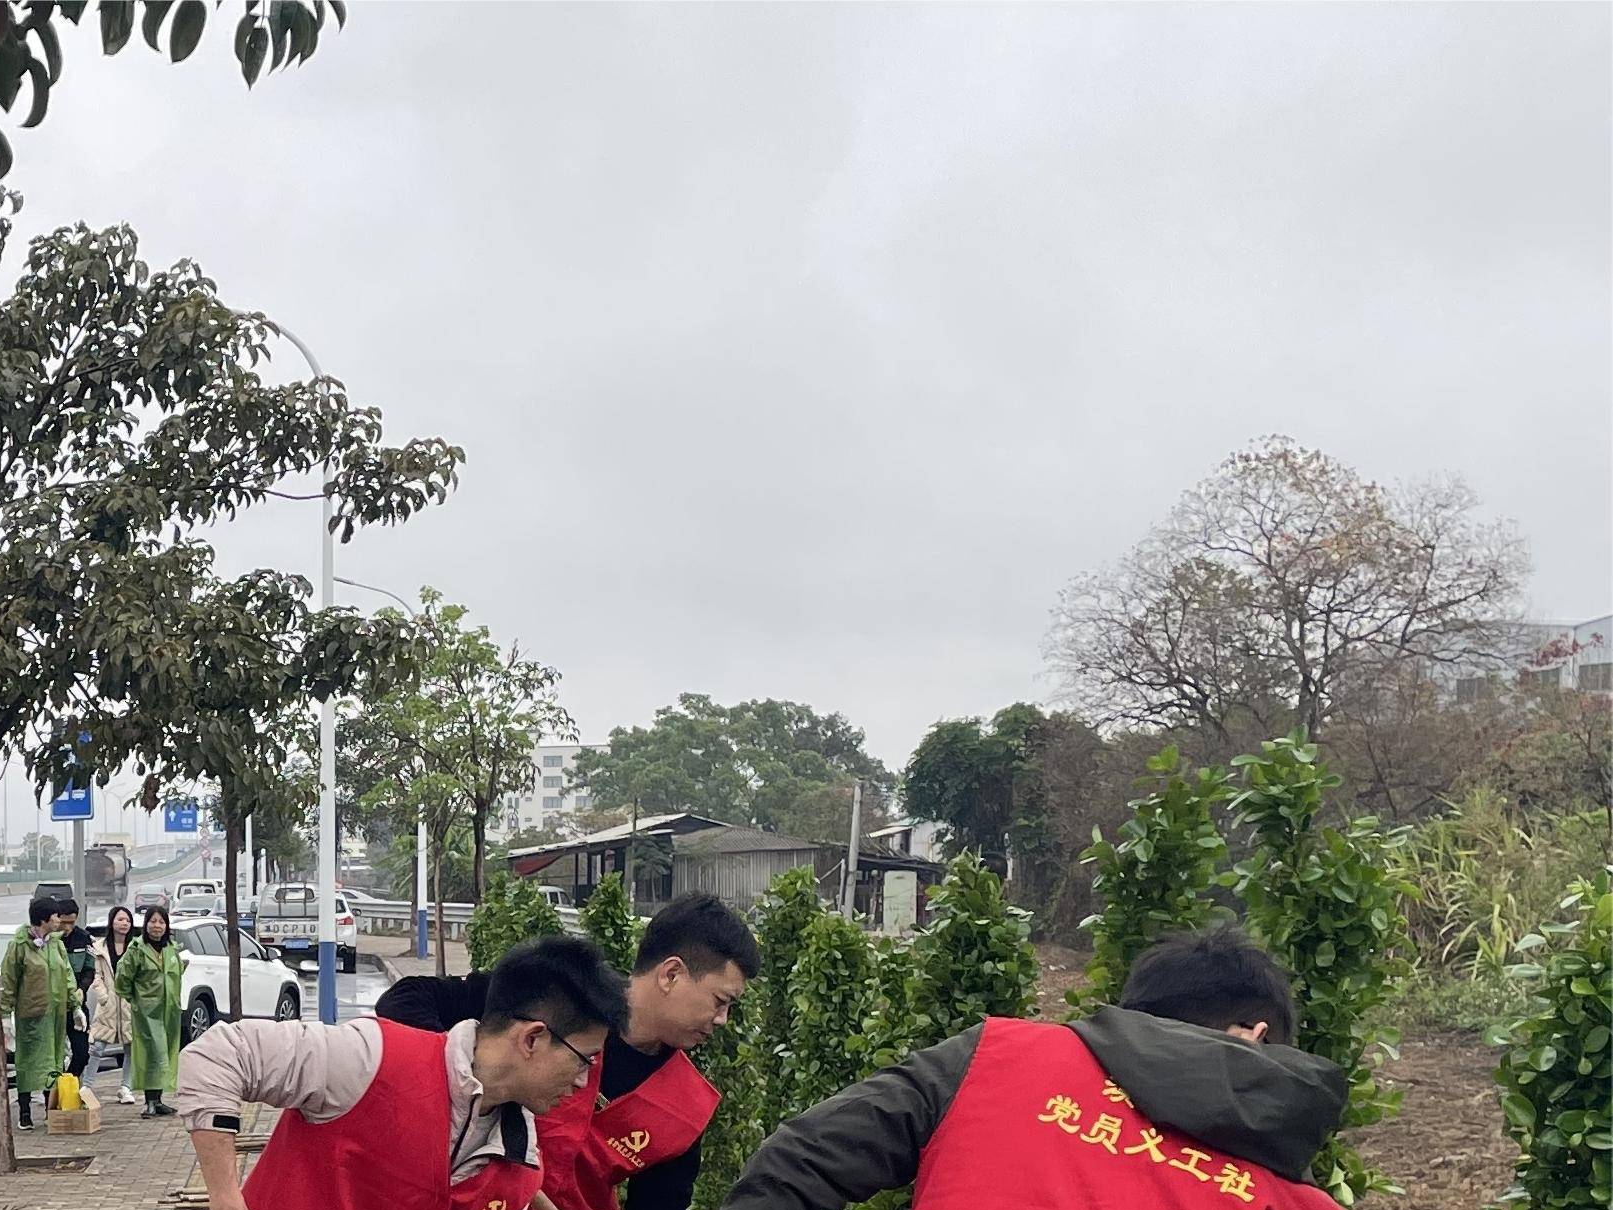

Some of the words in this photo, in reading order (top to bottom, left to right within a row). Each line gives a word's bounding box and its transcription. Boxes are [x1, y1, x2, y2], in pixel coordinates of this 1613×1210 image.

[1038, 1094, 1255, 1202] 党员义工社
